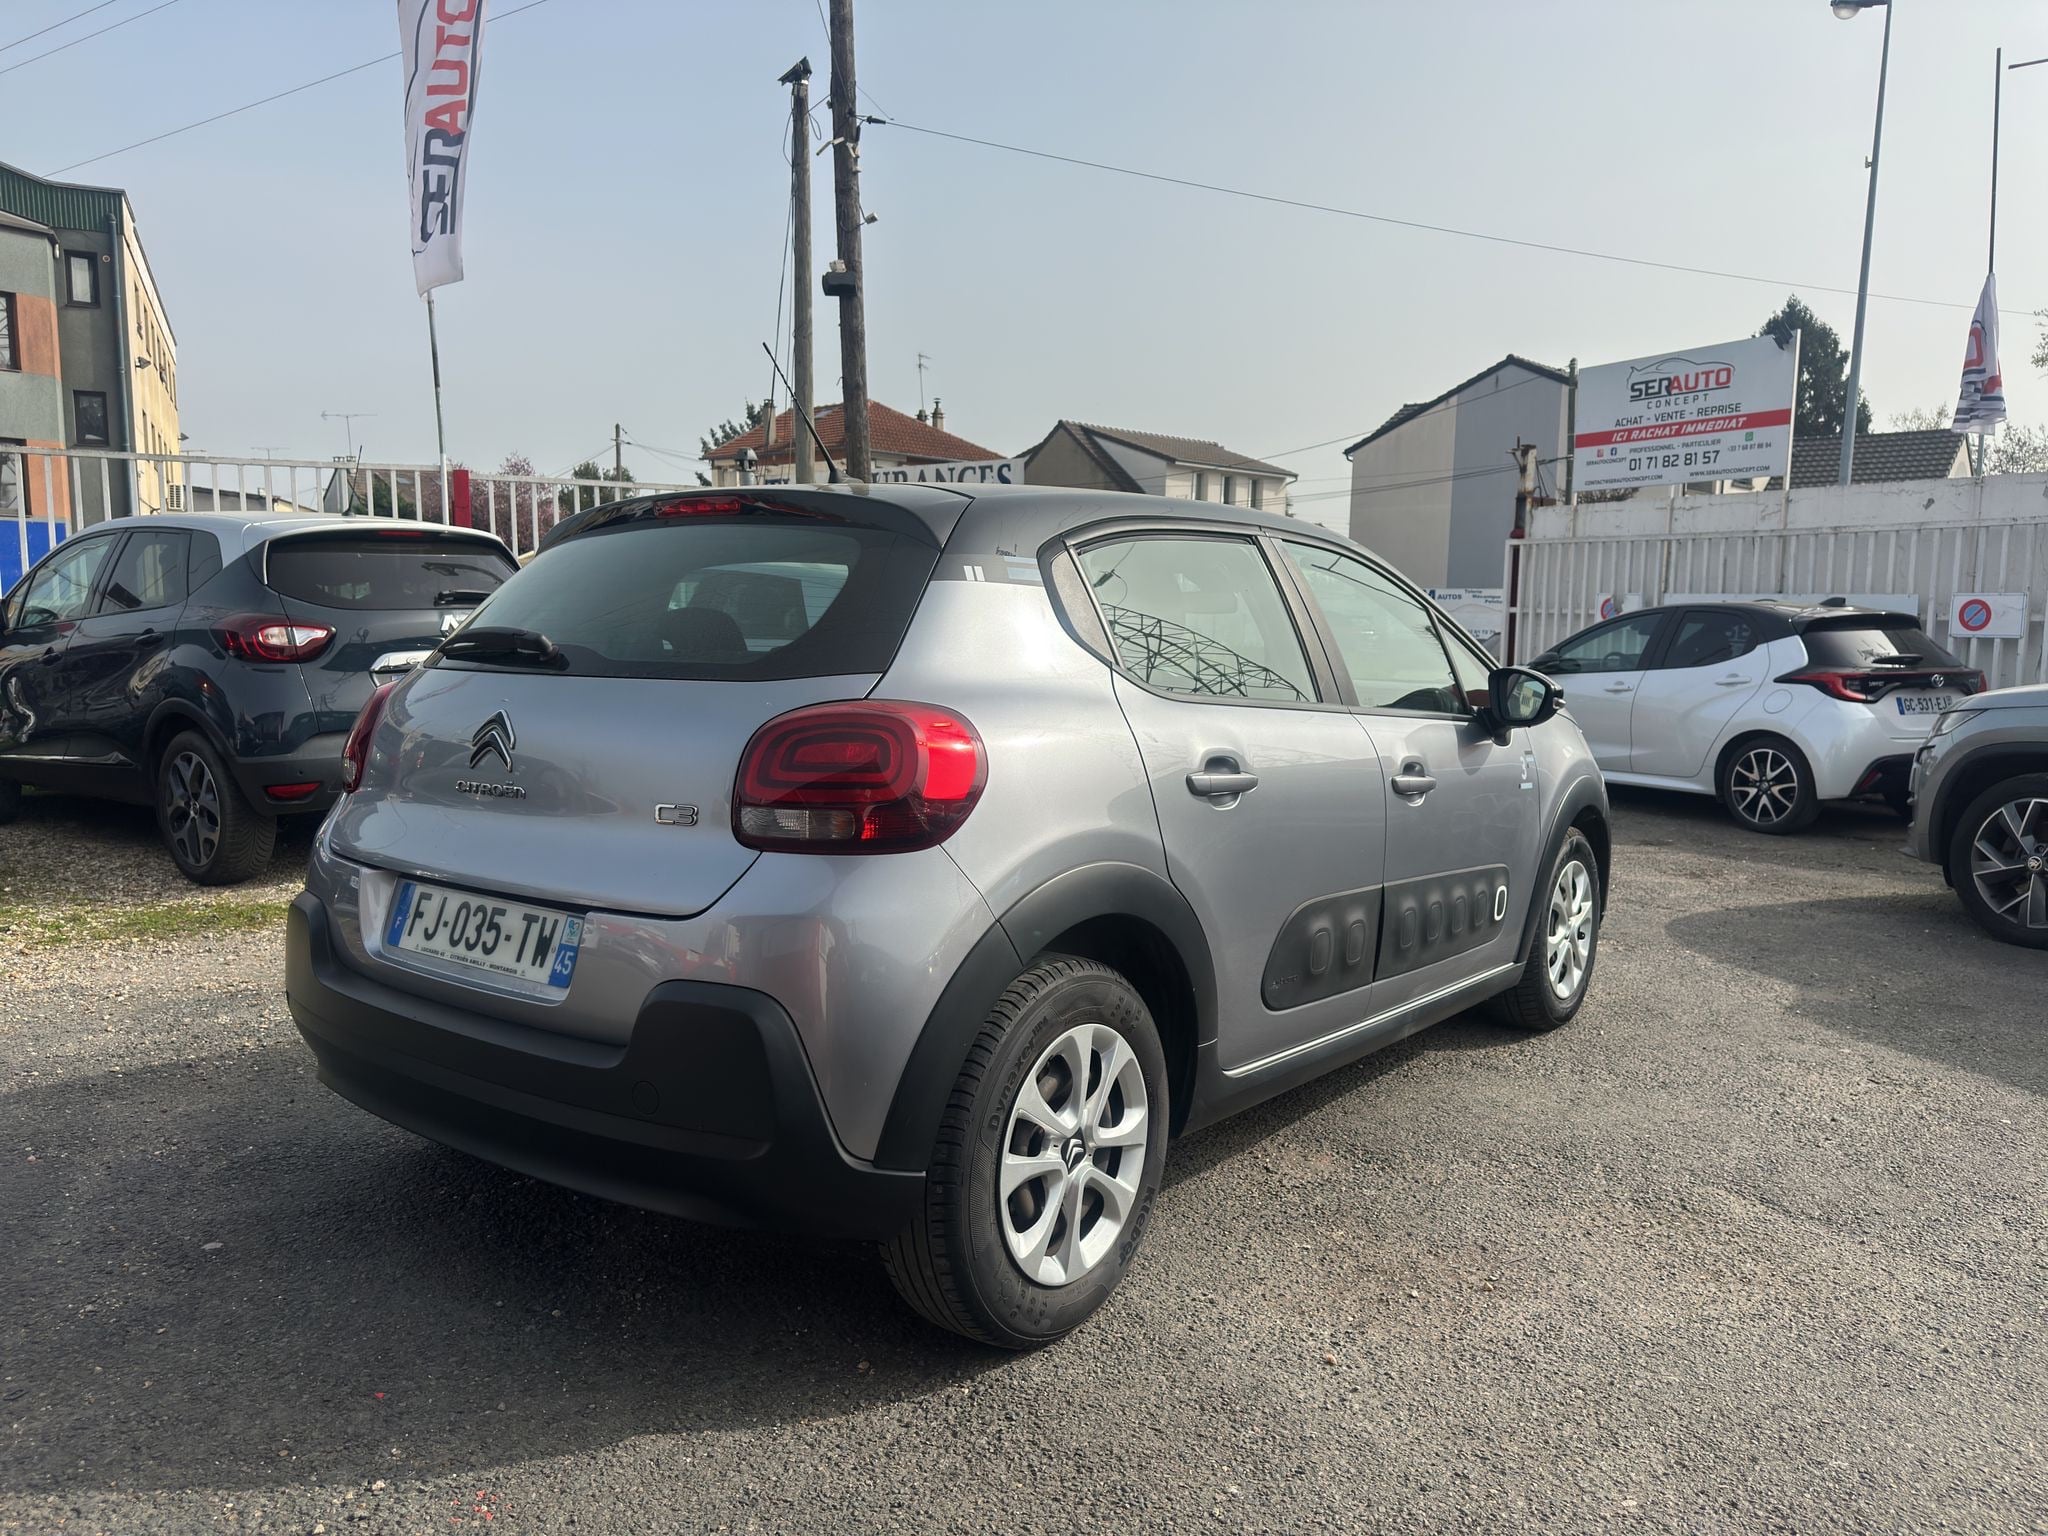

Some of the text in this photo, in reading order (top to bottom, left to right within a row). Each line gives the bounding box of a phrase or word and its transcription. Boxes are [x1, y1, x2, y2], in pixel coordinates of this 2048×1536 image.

[1630, 367, 1733, 400] SERAUTO
[1646, 393, 1709, 410] CONCEPT
[1614, 402, 1742, 428] ACHAT VENTE REPRISE
[1611, 417, 1747, 443] ICI RACHAT IMMEDIAT
[1629, 438, 1722, 455] PROFESSIONNEL PARTICULIER
[1629, 449, 1721, 471] 01 71 82 81 57
[1689, 464, 1771, 478] WWW.SERAUTOCONCEPT.COM
[654, 803, 699, 827] C3
[407, 891, 560, 969] FJ-035-TW
[553, 951, 573, 976] 45
